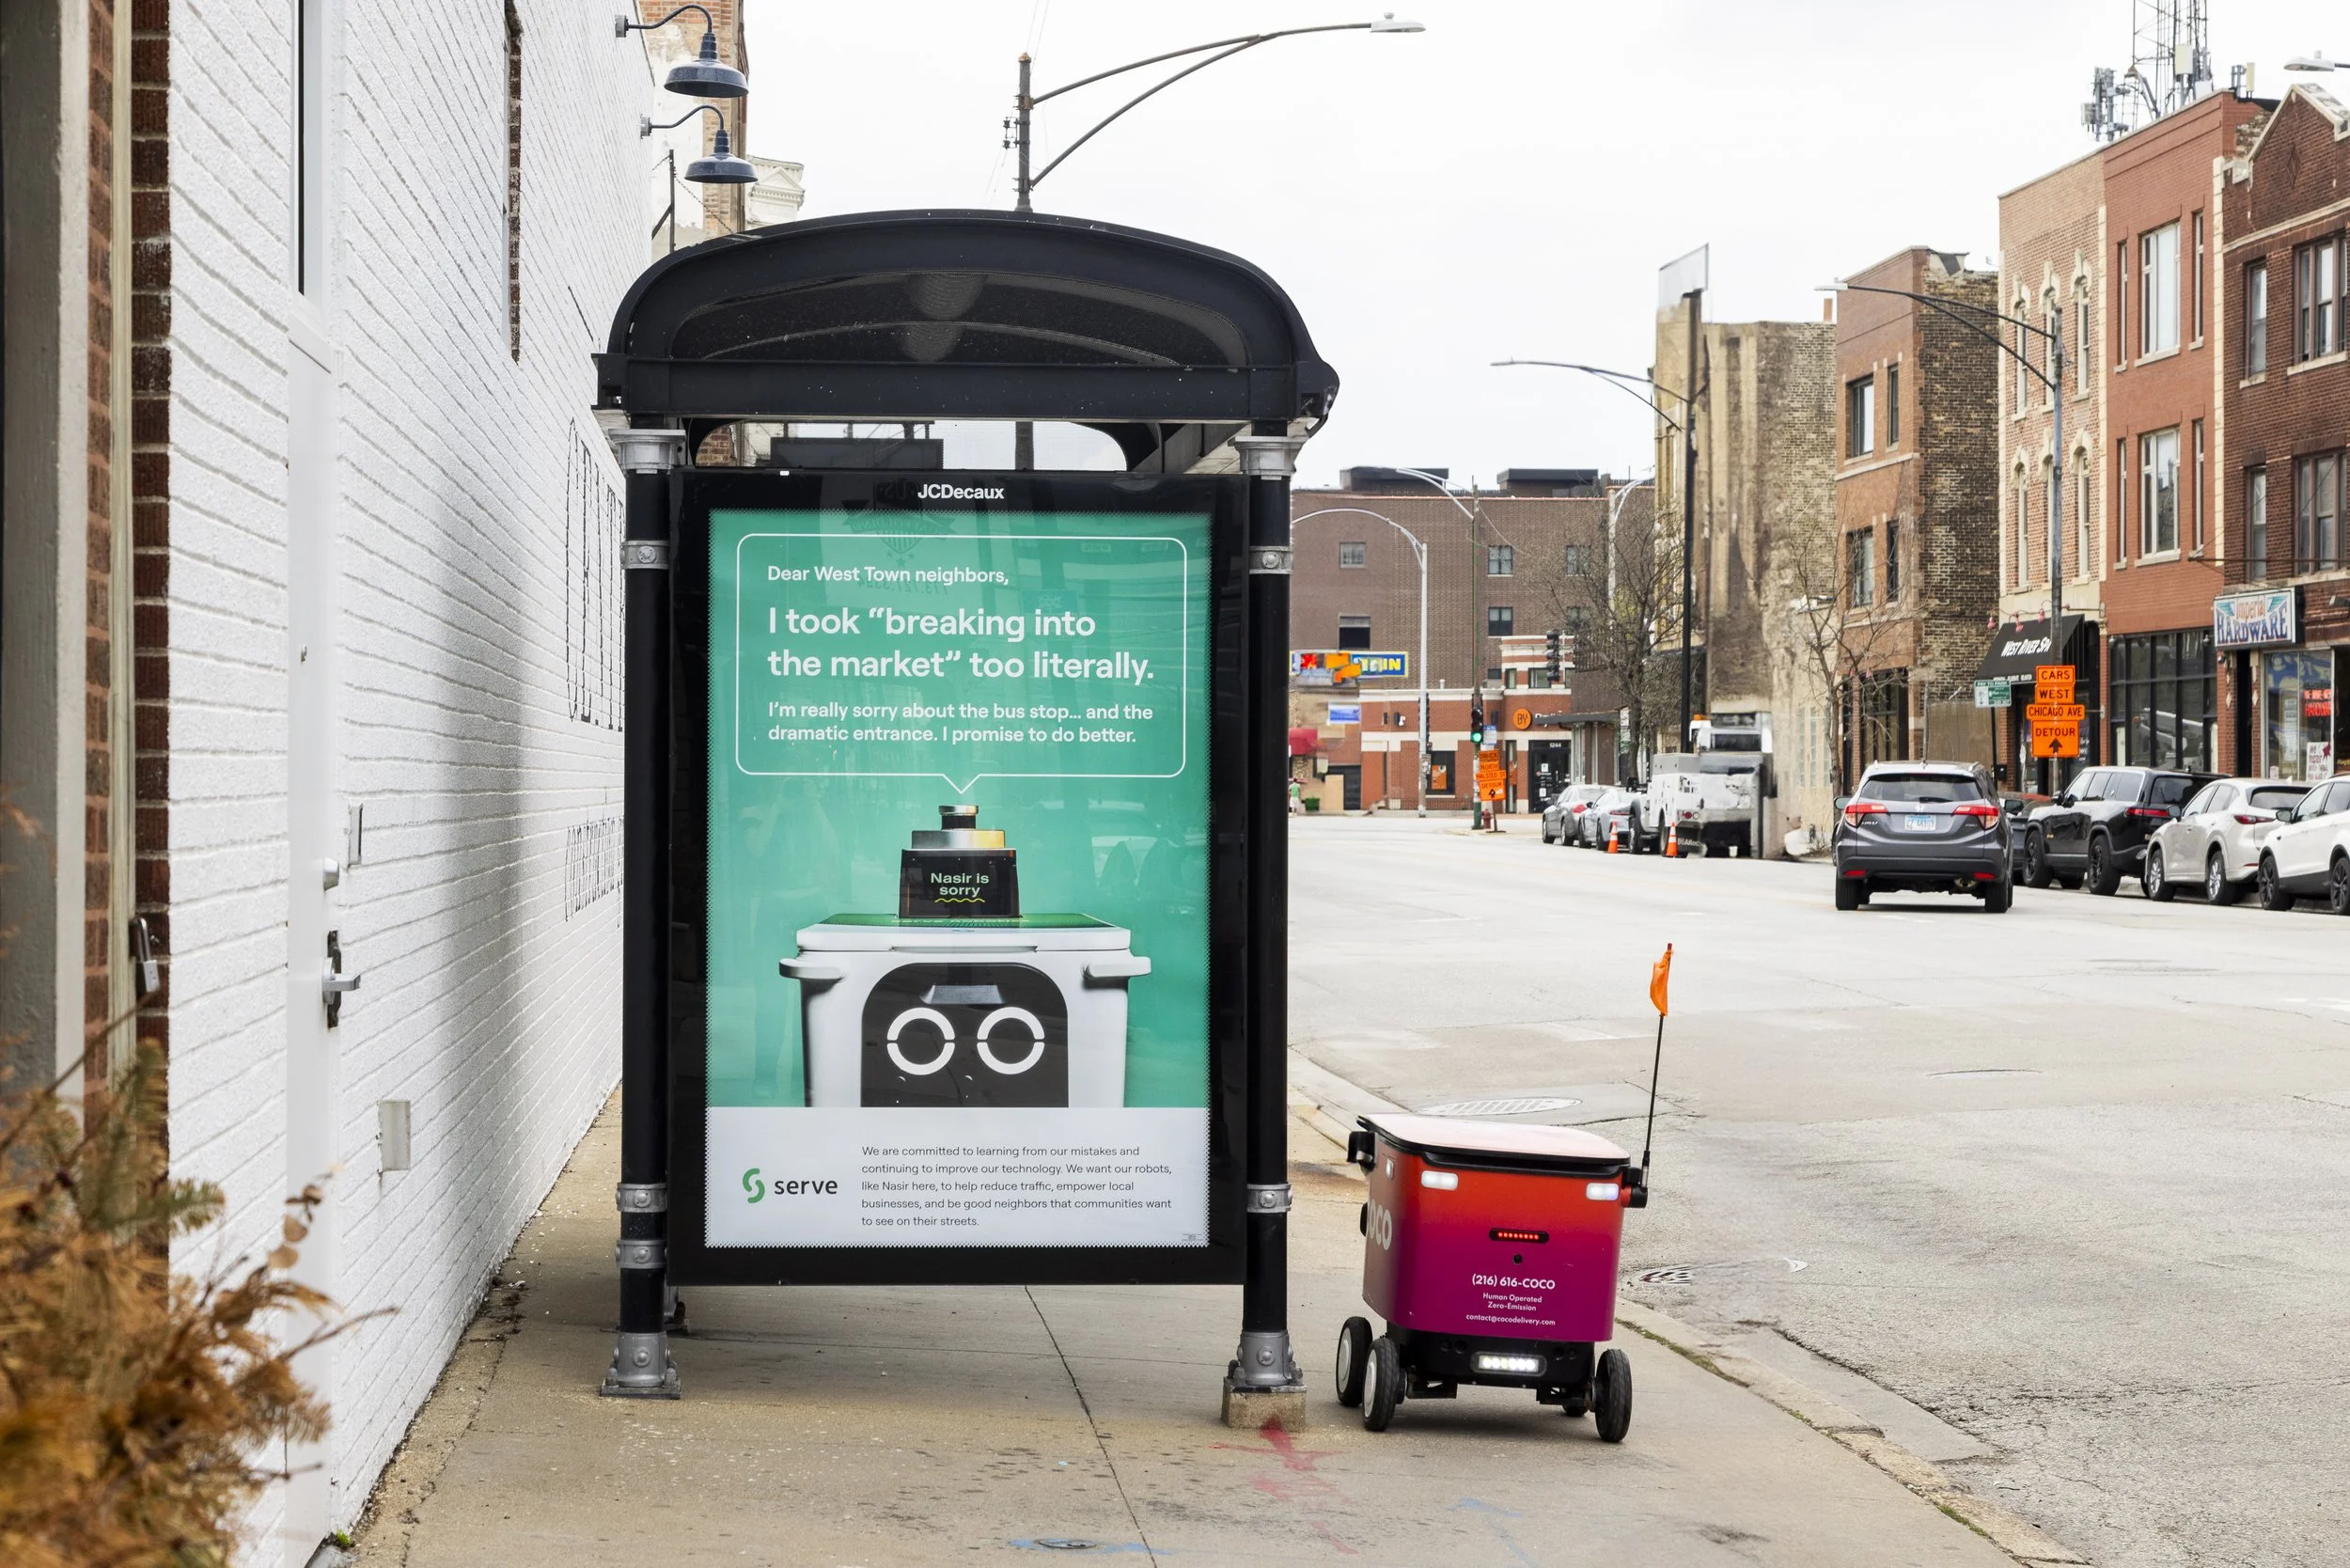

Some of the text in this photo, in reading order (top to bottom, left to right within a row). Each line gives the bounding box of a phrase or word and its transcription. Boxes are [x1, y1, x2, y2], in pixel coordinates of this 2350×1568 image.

[917, 484, 1004, 499] JCDecaux
[769, 566, 1008, 586] Dear West Town neighbors,
[770, 607, 1095, 642] I took “breaking into
[2216, 602, 2288, 644] HARDWARE
[768, 650, 1153, 685] the market” too literally.
[2041, 670, 2070, 680] CARS
[2040, 689, 2070, 699] WEST
[801, 702, 848, 721] really
[853, 707, 980, 721] sorry
[902, 703, 954, 718] about
[959, 703, 988, 718] the
[994, 703, 1025, 718] bus
[1030, 705, 1081, 722] stop...
[1087, 704, 1119, 718] and
[1123, 705, 1152, 719] the
[2029, 706, 2083, 716] CHICAGO AVE
[1517, 713, 1528, 725] BY
[769, 725, 1136, 745] dramatic entrance. I promise to do better.
[2035, 728, 2076, 737] DETOUR
[932, 873, 989, 884] Nasir is
[940, 887, 980, 898] sorry
[862, 1146, 880, 1156] We
[882, 1148, 900, 1156] are
[901, 1146, 960, 1156] committed
[963, 1147, 974, 1156] to
[976, 1146, 1019, 1158] learning
[1022, 1146, 1047, 1156] from
[1071, 1146, 1118, 1156] mistakes
[1120, 1147, 1140, 1156] and
[861, 1164, 919, 1176] continuing
[921, 1165, 933, 1173] to
[935, 1164, 979, 1175] improve
[1001, 1164, 1064, 1176] technology.
[1065, 1164, 1084, 1173] We
[1086, 1165, 1111, 1173] want
[1135, 1164, 1172, 1175] robots,
[775, 1181, 838, 1195] serve
[861, 1181, 1135, 1193] like Nasir here, to help reduce traffic, empower local
[861, 1199, 1172, 1211] businesses, and be good neighbors that communities want
[861, 1216, 873, 1226] to
[913, 1215, 938, 1226] their
[940, 1216, 980, 1226] streets.
[1472, 1274, 1556, 1290] (216) 616-COCO
[1482, 1293, 1543, 1303] Human Operated
[1487, 1301, 1537, 1311] Zero-Emission
[1465, 1313, 1556, 1326] contact@cocodelivery.com
